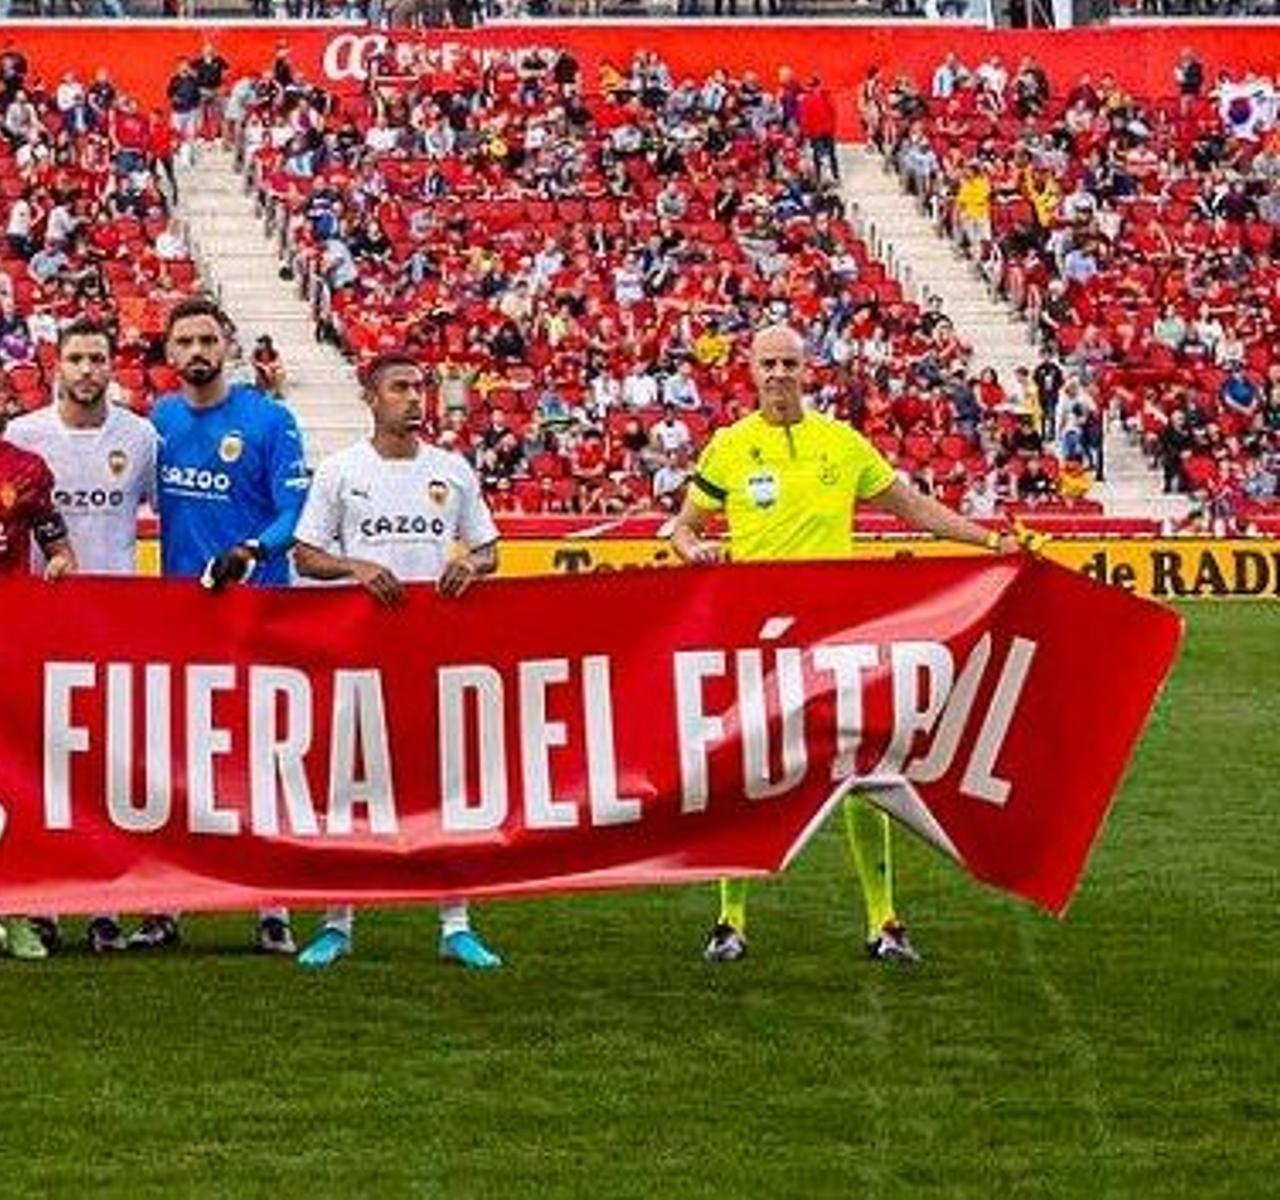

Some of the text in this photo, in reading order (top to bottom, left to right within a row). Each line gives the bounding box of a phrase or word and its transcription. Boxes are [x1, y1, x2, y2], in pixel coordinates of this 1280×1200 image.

[53, 490, 124, 506] AZOO
[360, 516, 443, 537] CAZOO
[44, 660, 398, 836] FUERA
[439, 654, 643, 836] DEL
